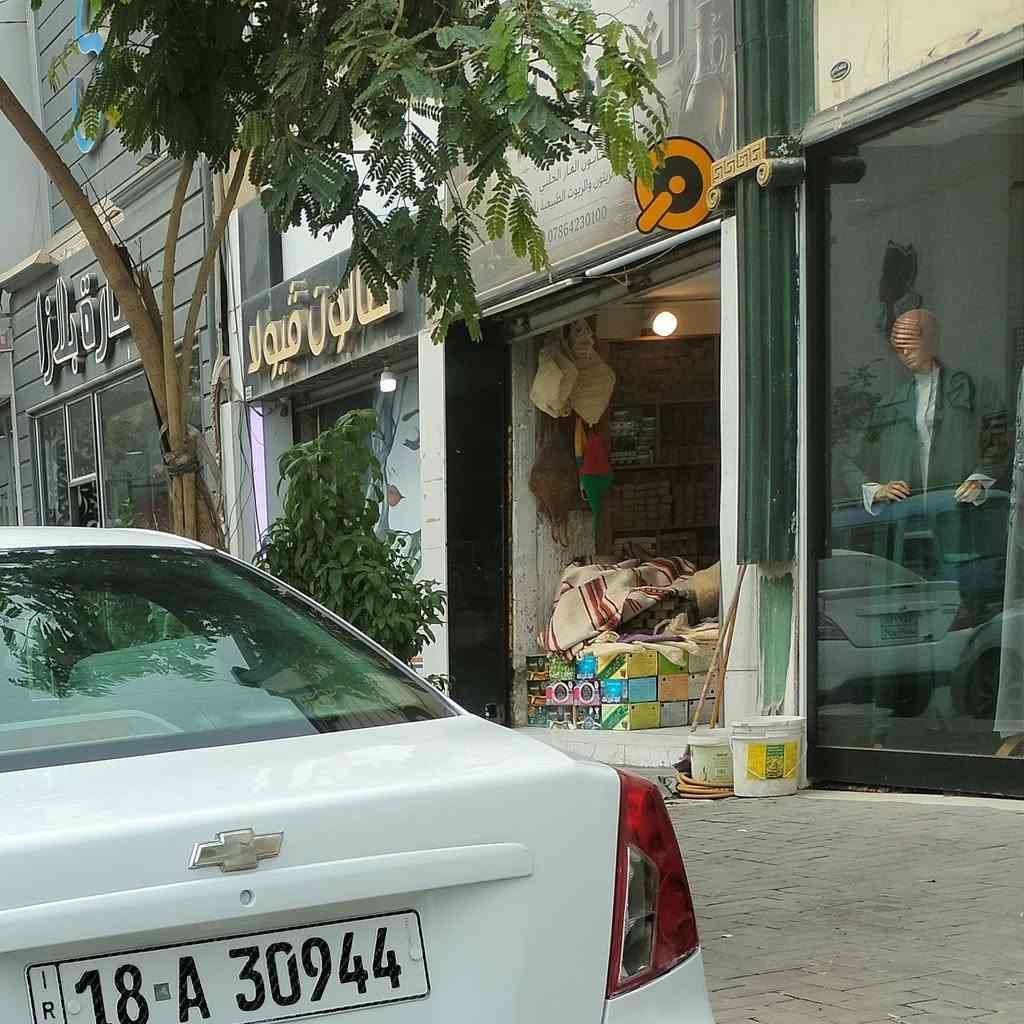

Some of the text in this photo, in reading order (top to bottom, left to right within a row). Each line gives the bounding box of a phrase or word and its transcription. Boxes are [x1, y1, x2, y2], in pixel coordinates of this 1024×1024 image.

[547, 205, 607, 241] 07864230100
[178, 956, 211, 1023] A
[228, 927, 402, 1012] 30944
